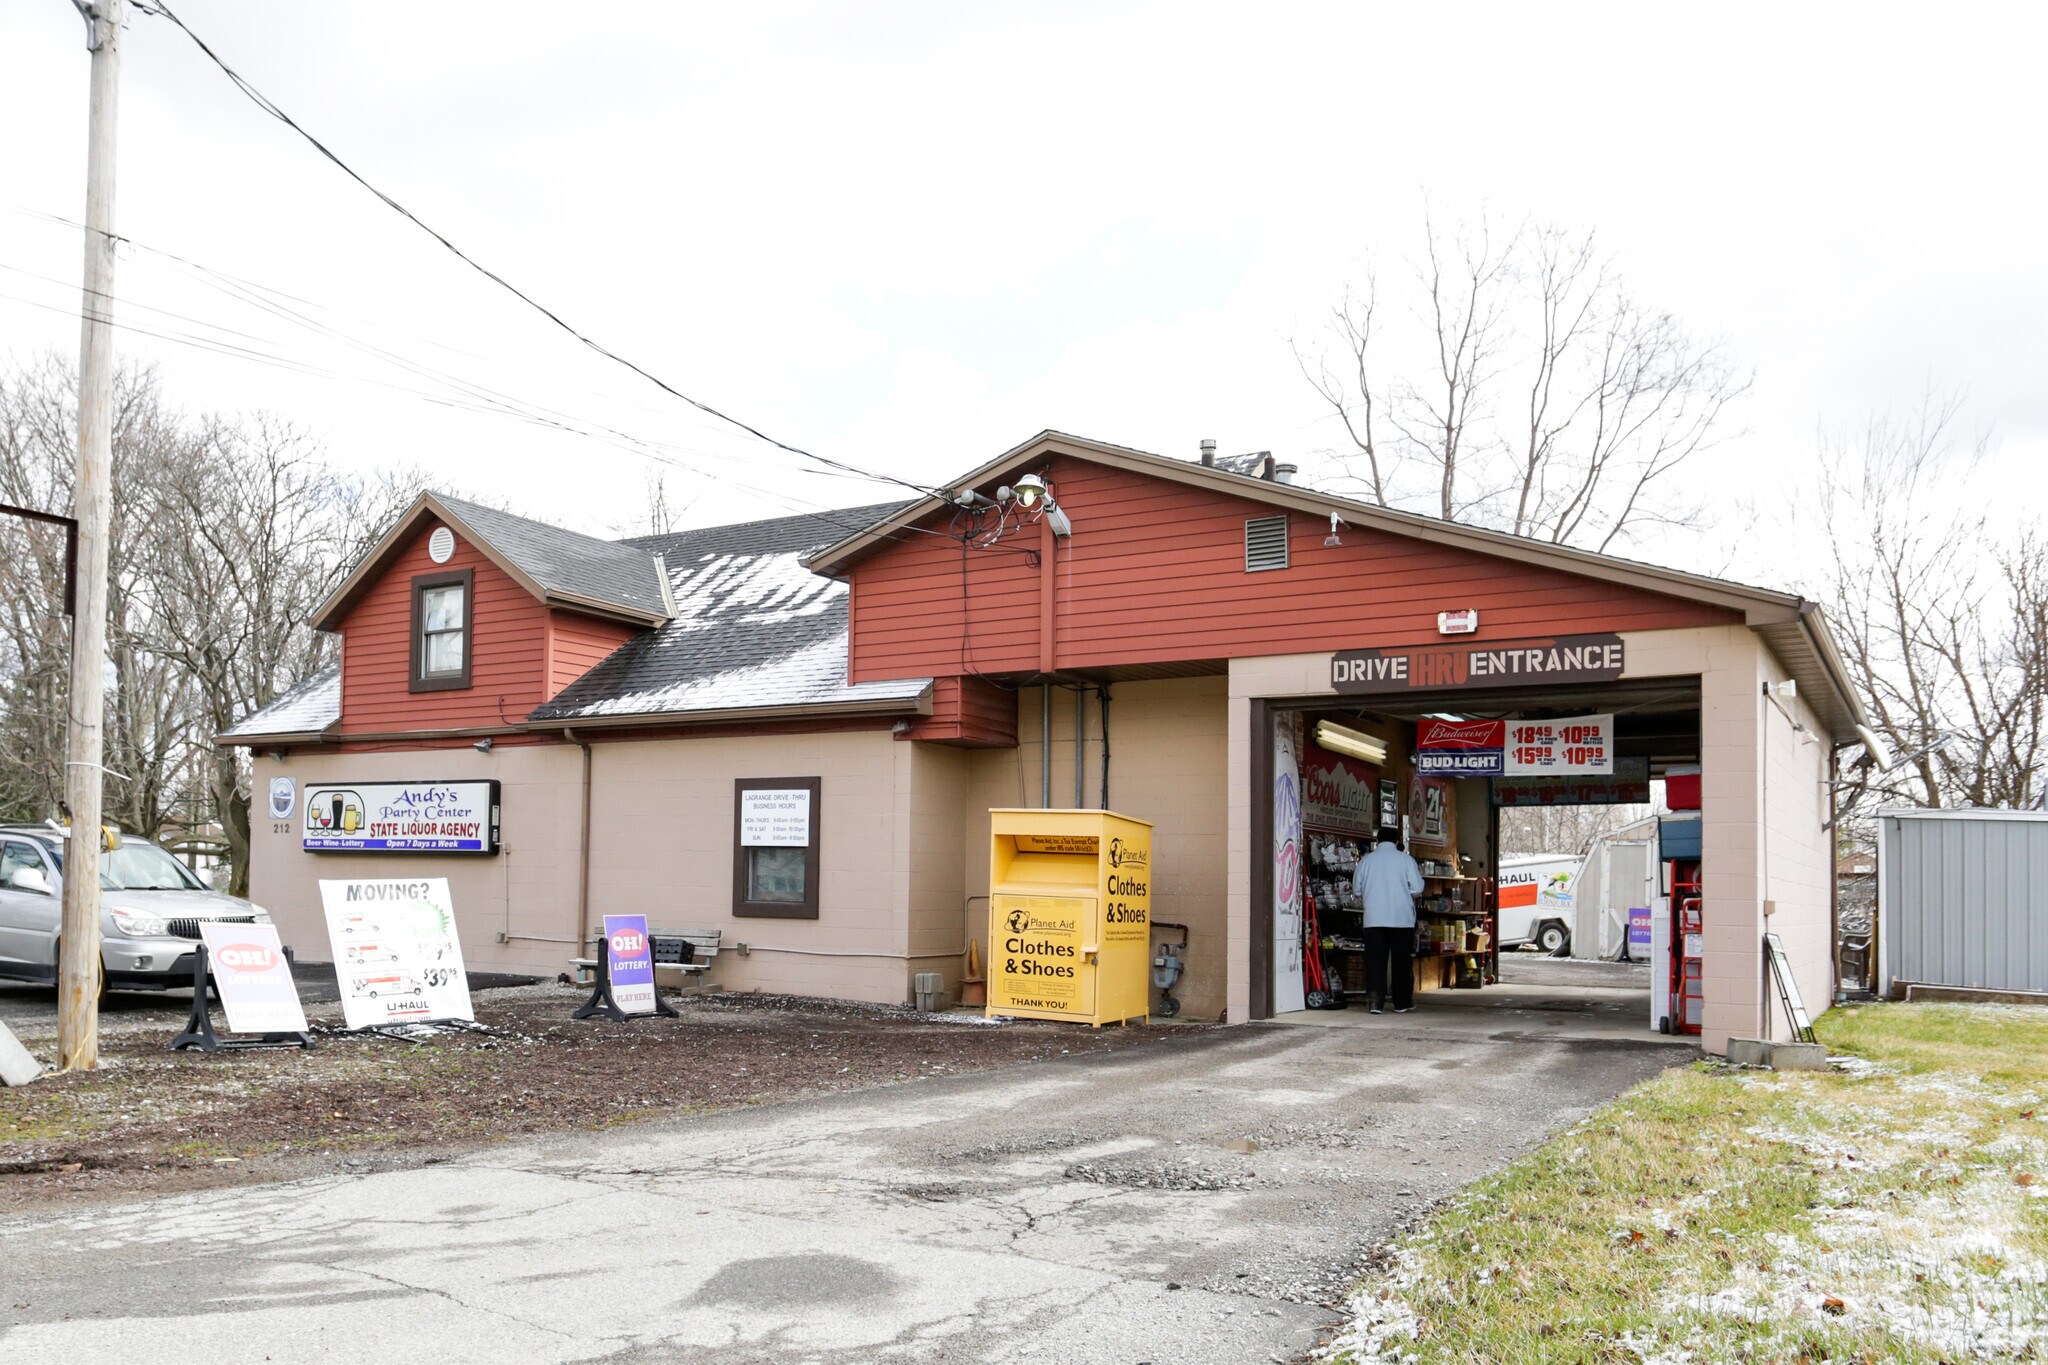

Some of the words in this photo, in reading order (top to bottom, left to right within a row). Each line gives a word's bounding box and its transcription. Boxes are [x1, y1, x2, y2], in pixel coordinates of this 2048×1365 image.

[1333, 656, 1407, 682] DRIVE
[1408, 651, 1470, 687] THRU
[1470, 645, 1622, 675] ENTRANCE
[1429, 727, 1490, 739] Budweiser
[1422, 757, 1453, 768] BUD
[1454, 756, 1498, 767] LIGHT
[1307, 764, 1340, 807] Coors
[393, 786, 458, 807] Andy's
[379, 806, 420, 822] Party
[424, 805, 472, 818] Center
[273, 823, 290, 833] 212
[370, 822, 398, 837] STATE
[402, 823, 437, 836] LIQUOR
[440, 823, 480, 838] AGENCY
[386, 840, 405, 848] Open
[412, 840, 430, 848] Days
[1123, 848, 1137, 860] Planet
[1139, 851, 1147, 861] Aid
[346, 883, 430, 901] MOVING?
[1107, 875, 1146, 896] Clothes
[1107, 902, 1115, 923] &
[1117, 902, 1146, 923] Shoes
[1031, 918, 1056, 928] Planet
[1059, 920, 1075, 929] Aid
[611, 932, 643, 952] OH!
[1005, 938, 1074, 957] Clothes
[220, 948, 271, 966] OH!
[1005, 958, 1018, 973] &
[1021, 959, 1074, 978] Shoes
[387, 1000, 430, 1011] U-HAUL
[634, 993, 652, 1001] HERE
[1011, 998, 1044, 1007] THANK
[1045, 1001, 1068, 1009] YOU!
